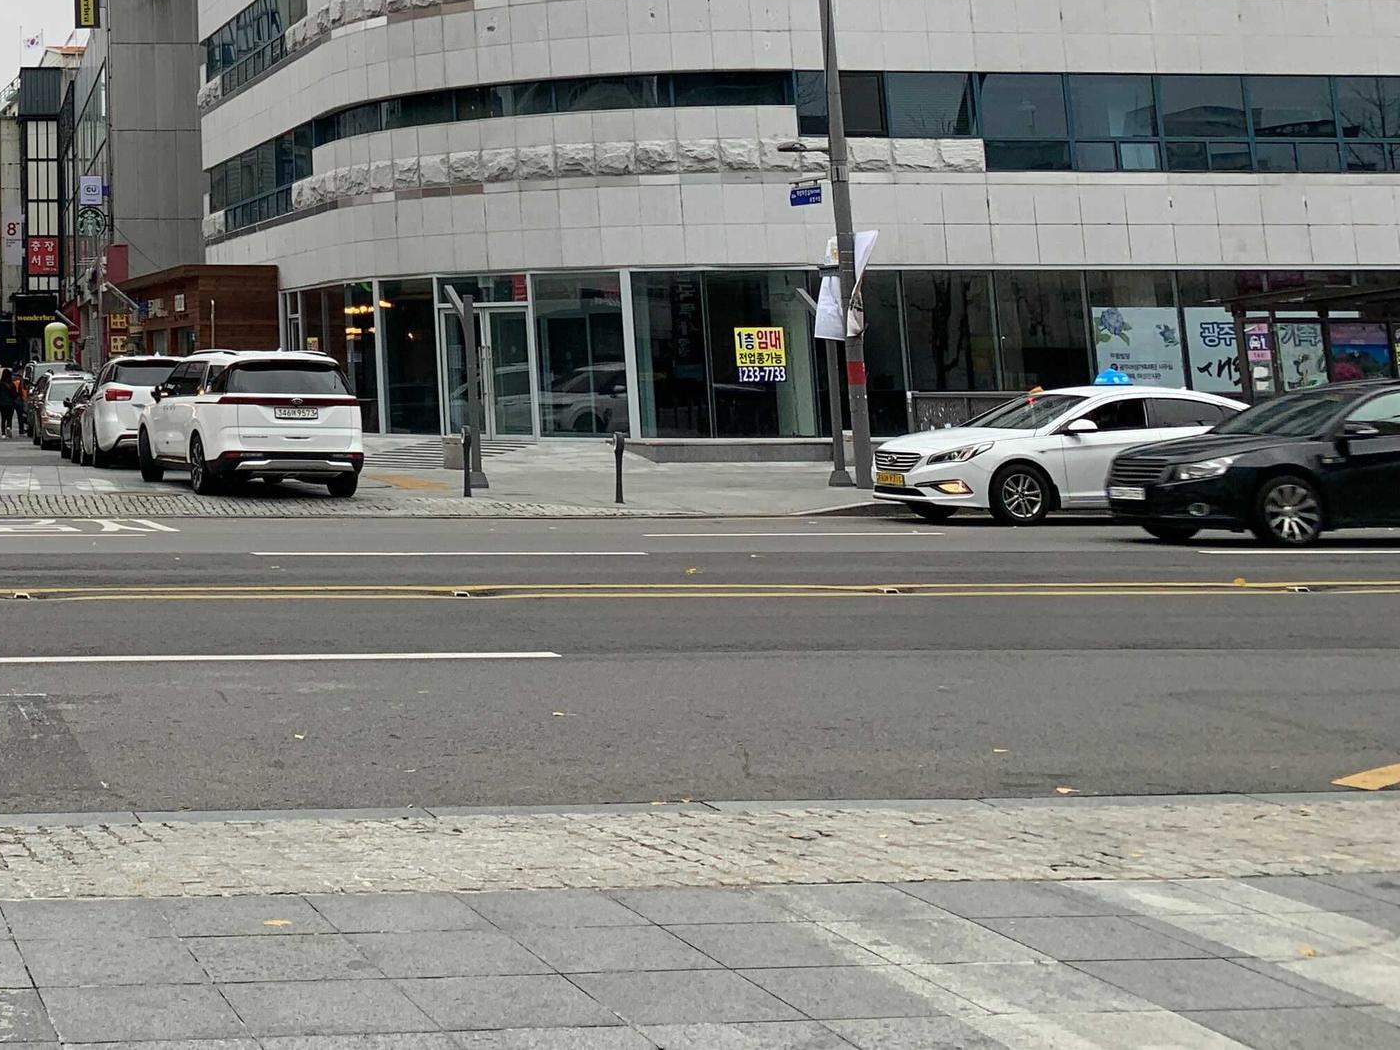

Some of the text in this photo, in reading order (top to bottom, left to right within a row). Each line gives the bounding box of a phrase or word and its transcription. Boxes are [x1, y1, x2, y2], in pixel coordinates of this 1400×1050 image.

[737, 330, 782, 351] 1층 임대
[1200, 321, 1237, 348] 광주
[739, 352, 783, 365] 전업종가능
[743, 366, 787, 382] 233-7733
